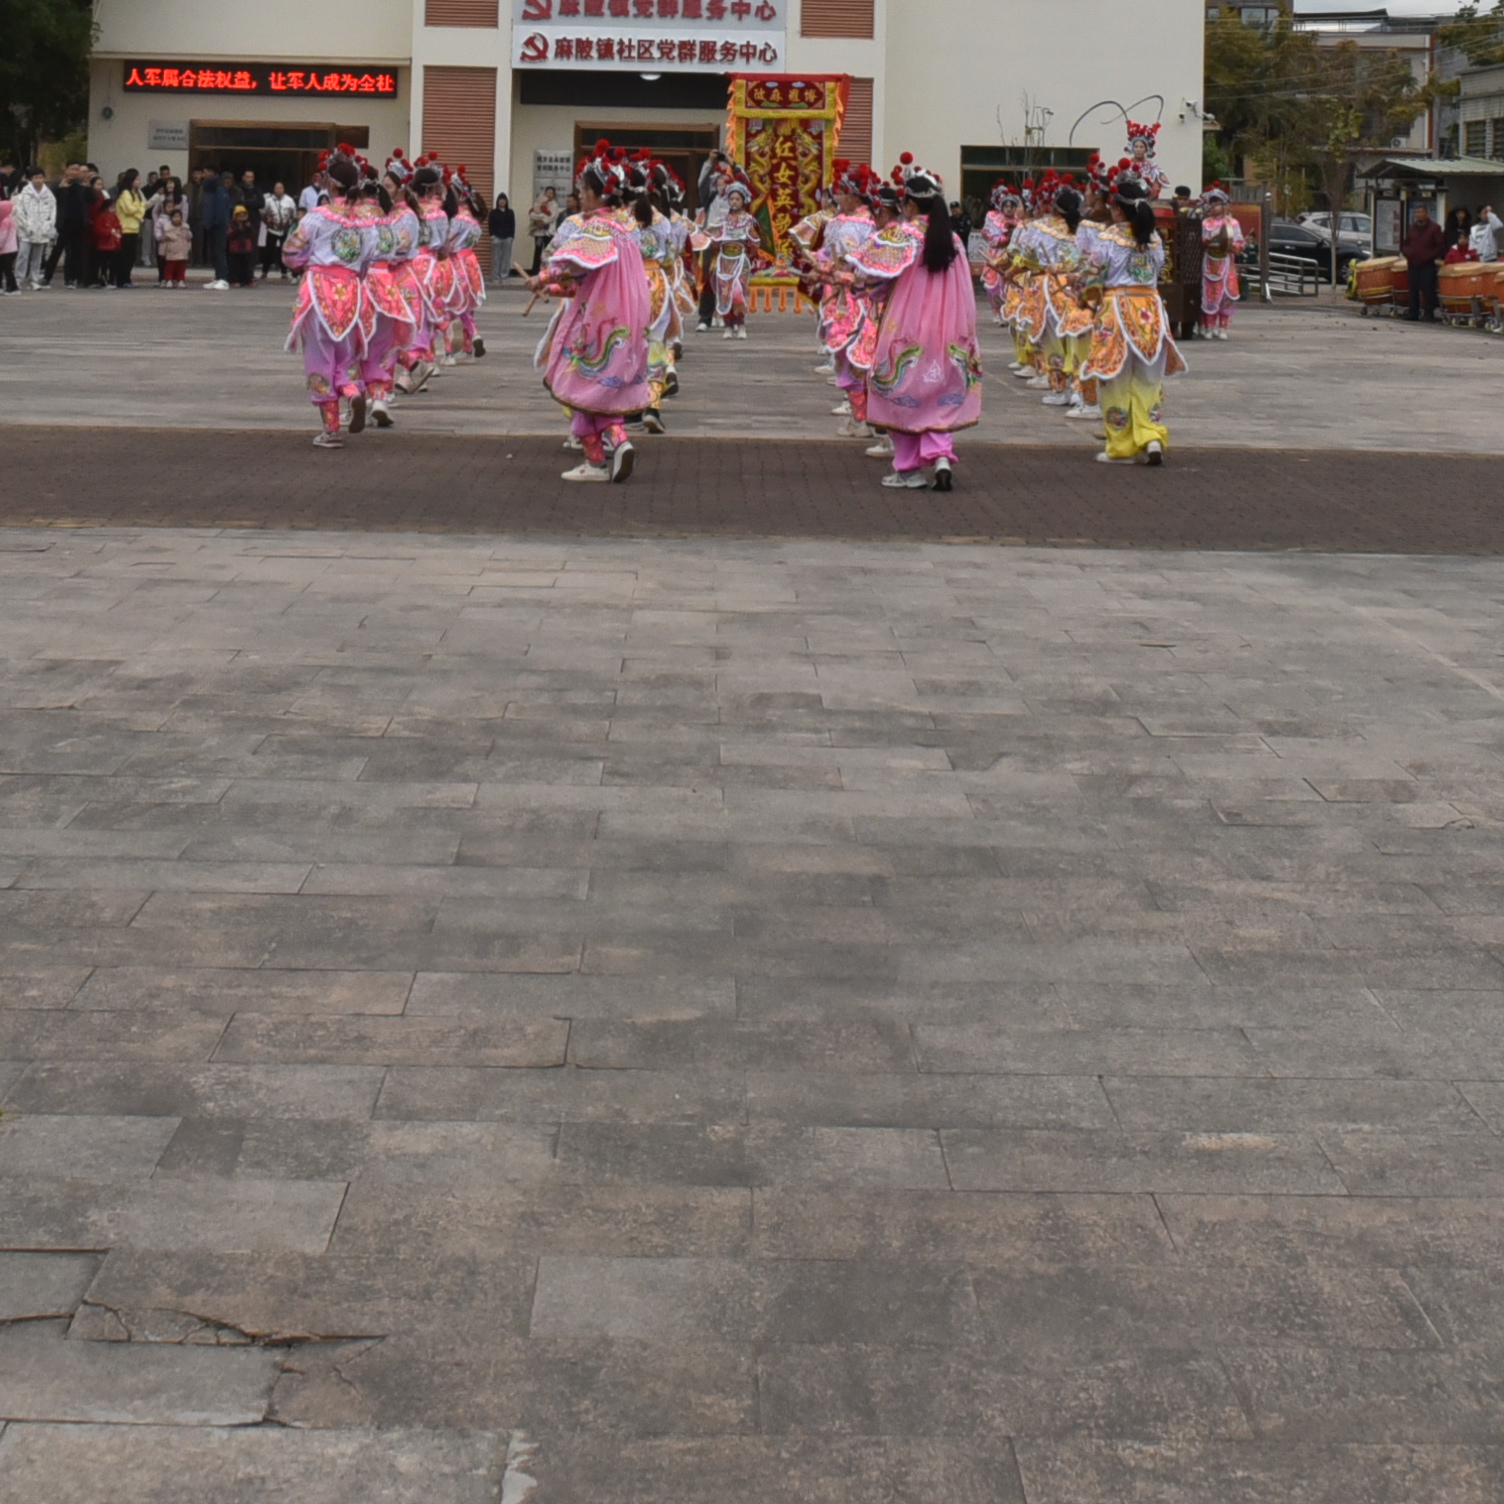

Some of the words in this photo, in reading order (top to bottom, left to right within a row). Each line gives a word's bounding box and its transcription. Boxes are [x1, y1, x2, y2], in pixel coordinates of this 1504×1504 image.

[554, 36, 778, 64] 麻陂镇社区党群服务中心
